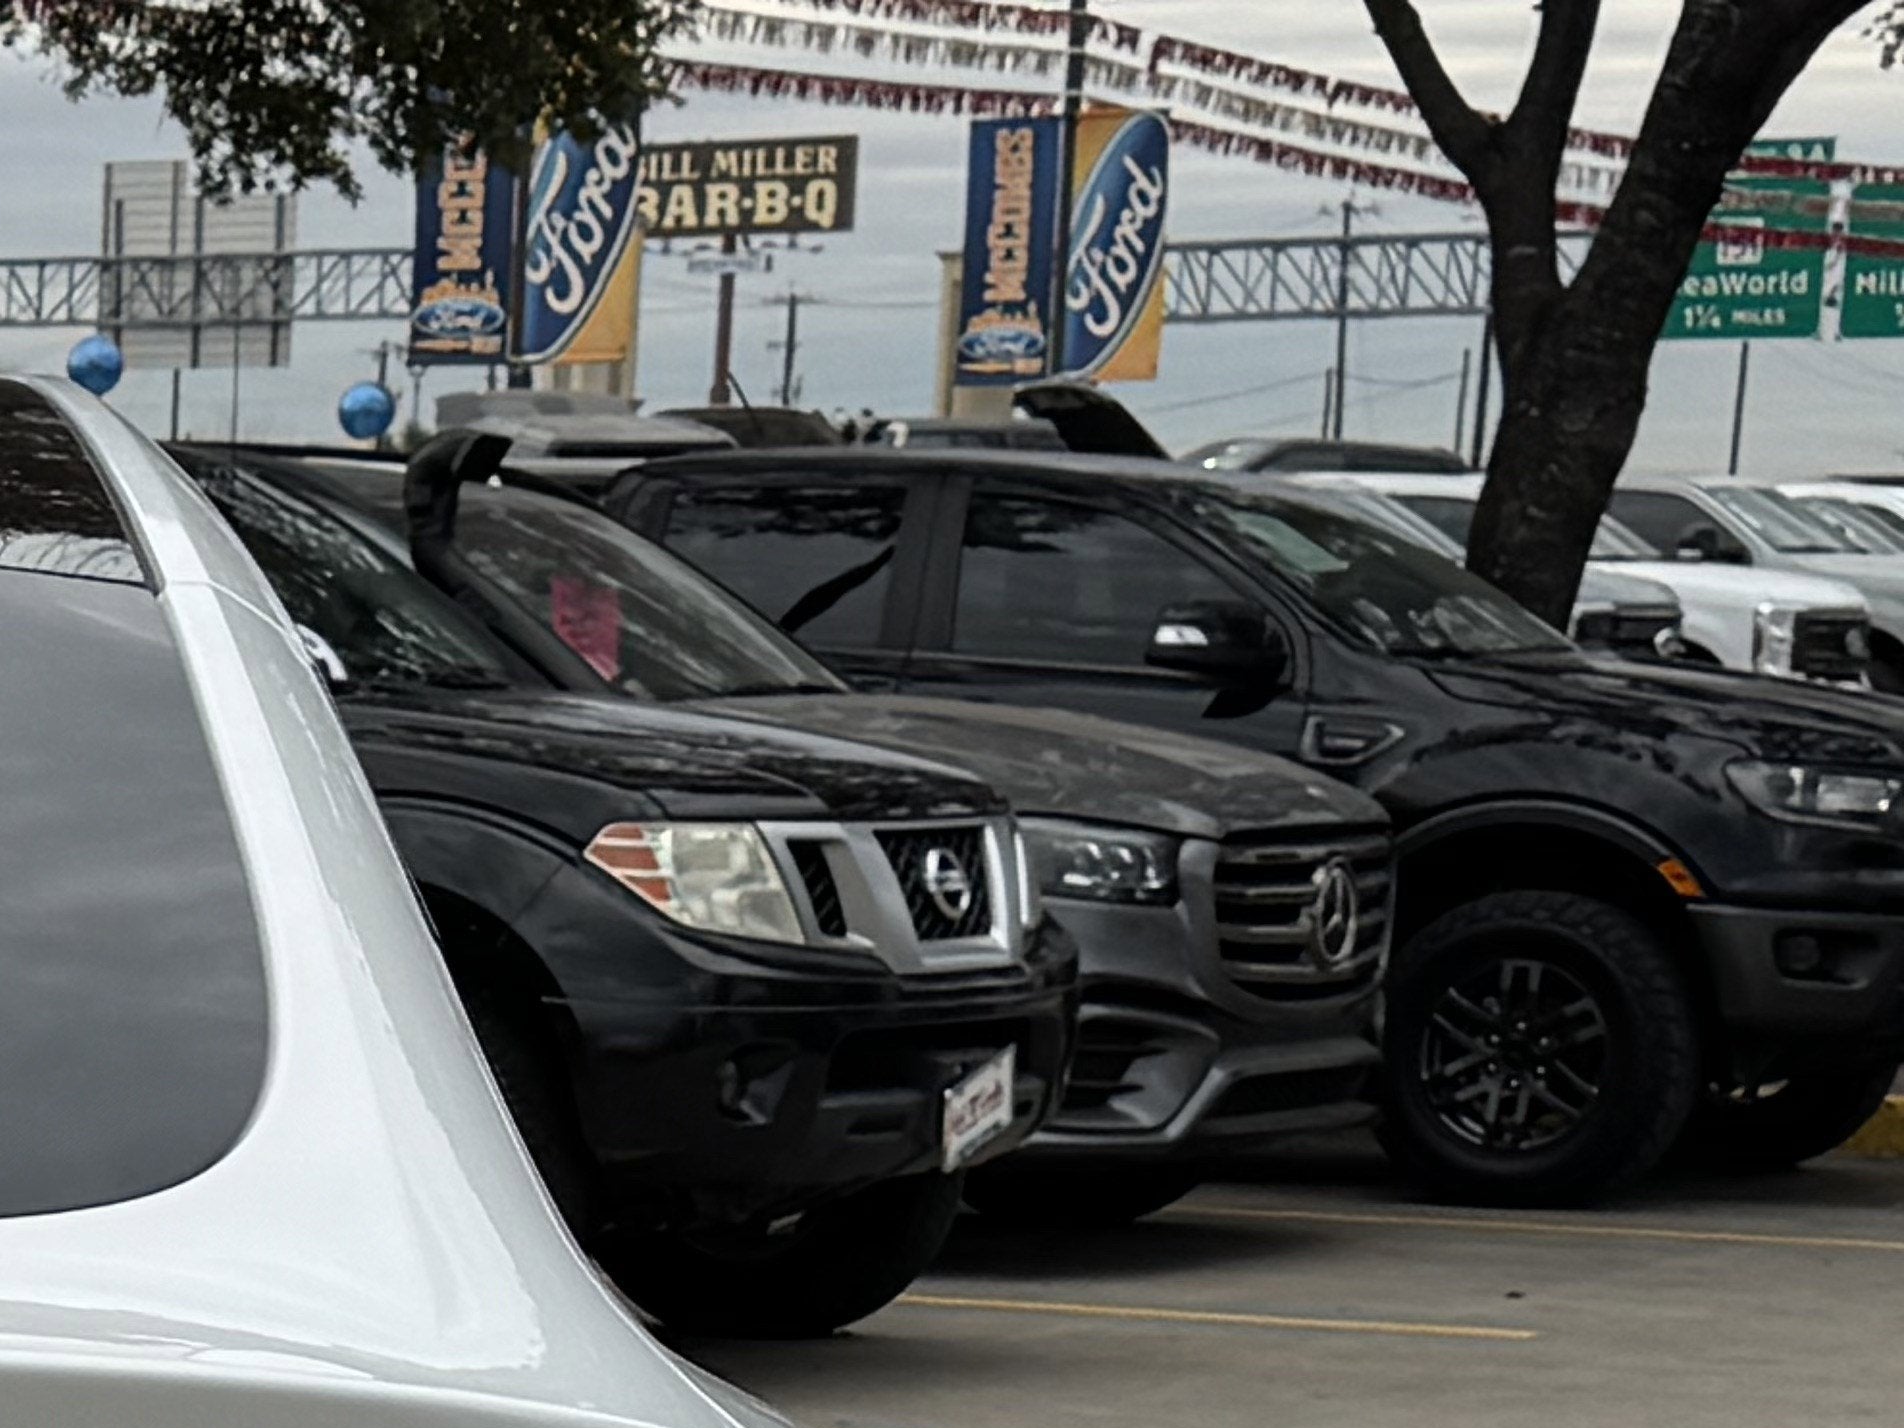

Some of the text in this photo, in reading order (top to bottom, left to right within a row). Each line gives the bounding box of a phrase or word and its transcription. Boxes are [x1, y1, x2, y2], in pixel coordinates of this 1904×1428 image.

[710, 145, 838, 178] MILLER
[525, 122, 636, 314] Ford
[1065, 154, 1164, 338] Ford
[1677, 269, 1808, 297] eaWorld
